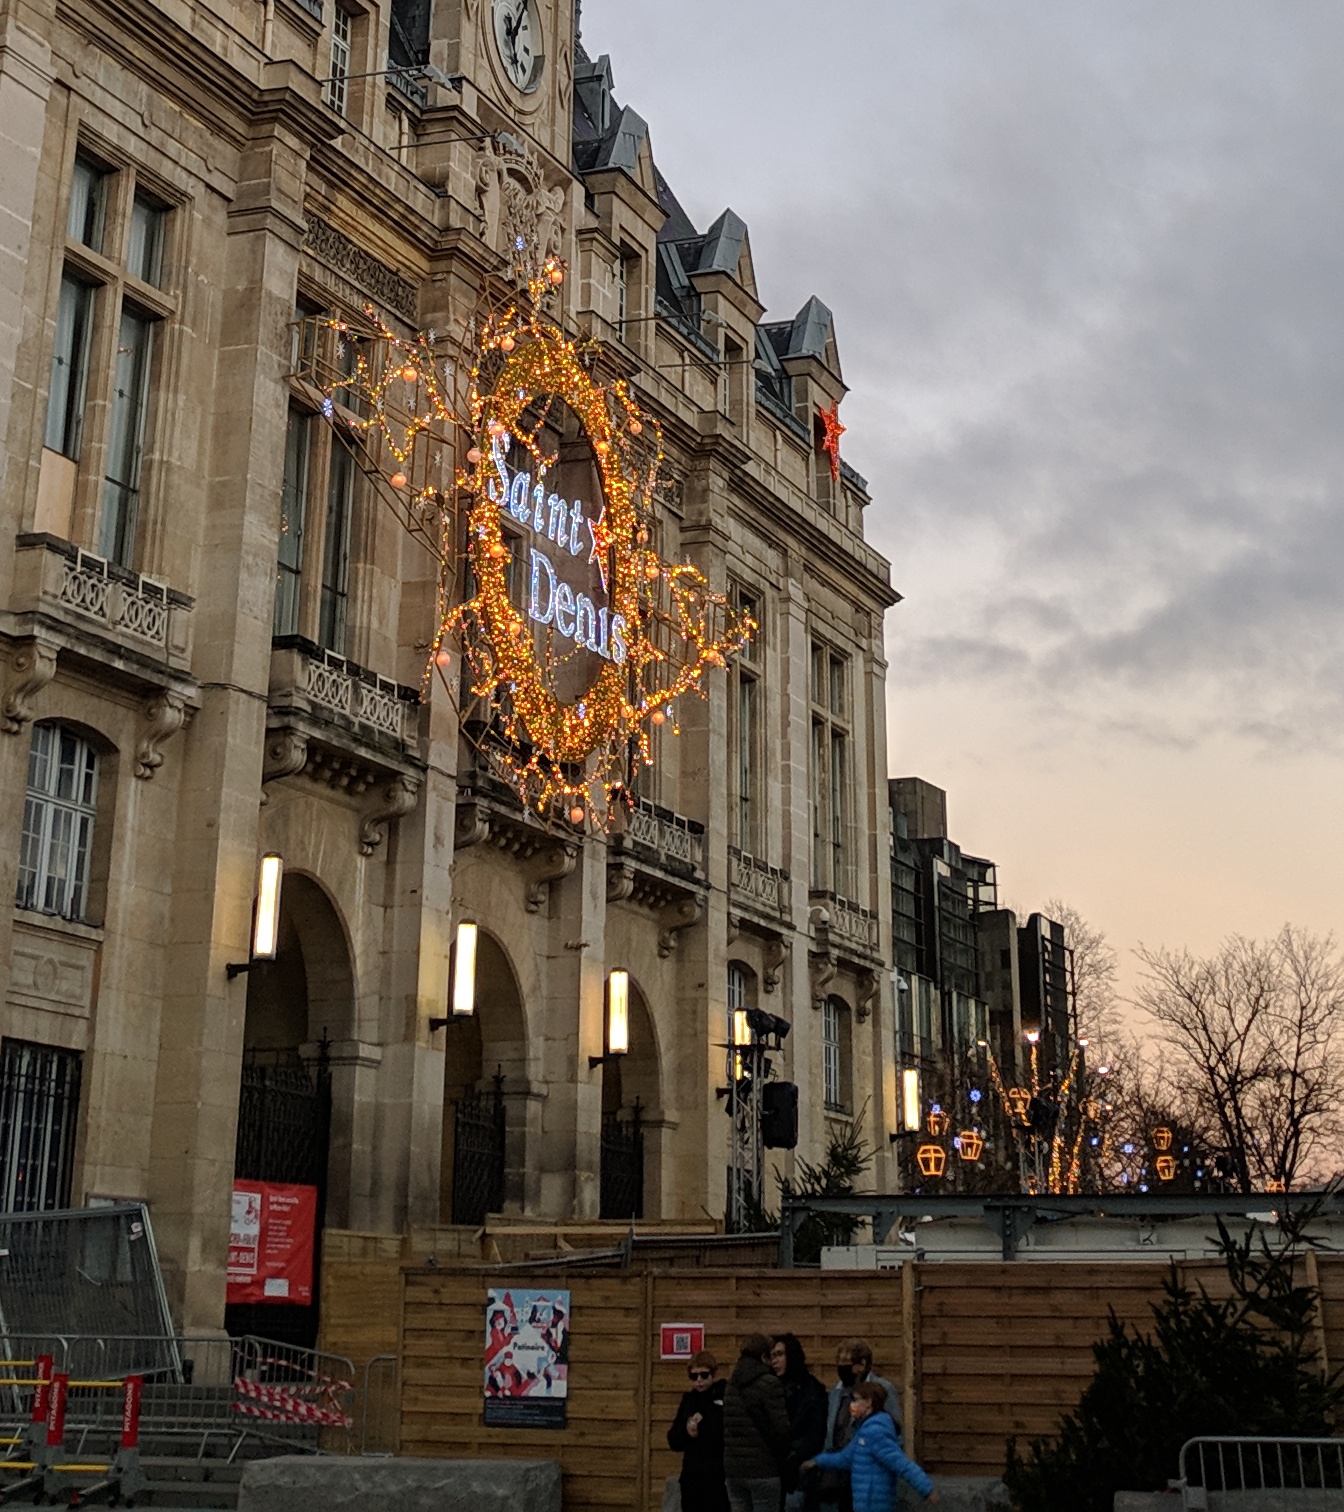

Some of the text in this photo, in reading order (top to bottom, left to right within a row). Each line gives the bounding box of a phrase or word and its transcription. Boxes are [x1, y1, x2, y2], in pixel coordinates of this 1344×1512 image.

[488, 431, 584, 556] Saint
[529, 548, 628, 664] Denis
[124, 1382, 134, 1432] PITAGONE
